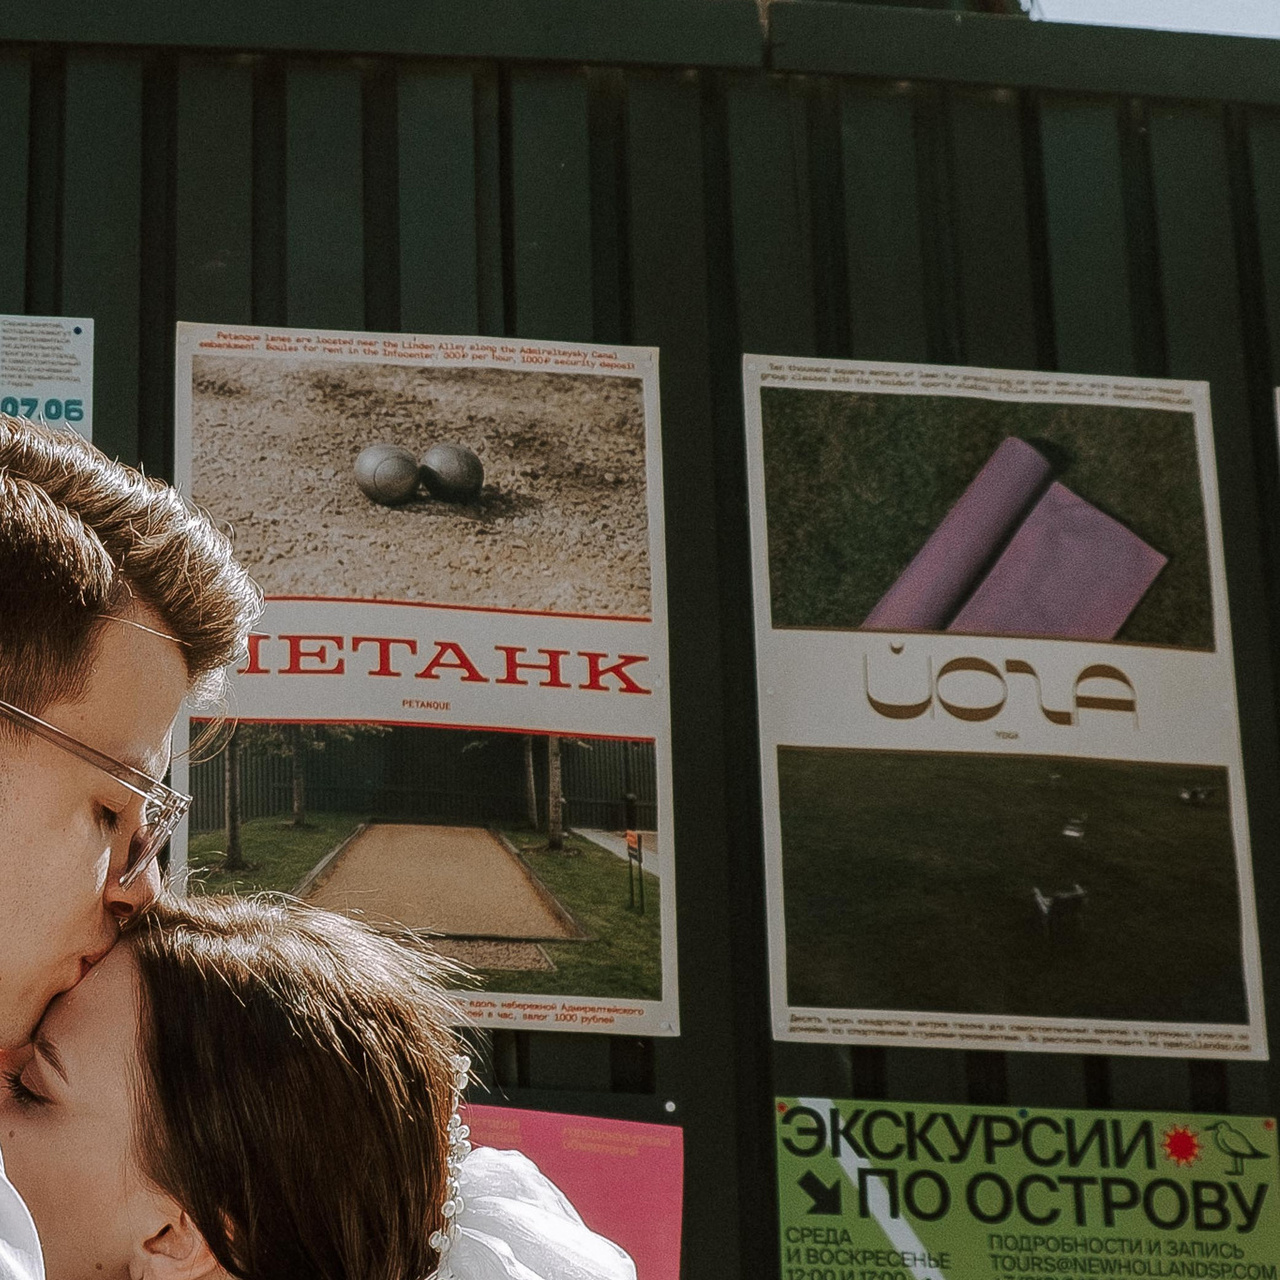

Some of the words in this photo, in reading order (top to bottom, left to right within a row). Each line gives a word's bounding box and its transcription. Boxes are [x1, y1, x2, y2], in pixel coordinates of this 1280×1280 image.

[217, 331, 261, 343] Petanque
[296, 336, 313, 344] are
[316, 336, 354, 346] located
[357, 339, 379, 347] near
[383, 339, 399, 349] the
[402, 341, 435, 351] Linden
[438, 342, 466, 353] Alley
[470, 343, 497, 354] along
[500, 344, 517, 354] the
[591, 351, 618, 360] Canal
[265, 342, 299, 352] Boules
[303, 344, 319, 352] for
[322, 345, 344, 354] rent
[348, 346, 359, 355] in
[363, 347, 379, 356] the
[471, 353, 487, 362] per
[492, 353, 517, 365] hour,
[554, 357, 596, 369] security
[599, 361, 635, 371] deposit
[1, 397, 84, 421] 07.06
[401, 698, 451, 711] PETANQUE
[469, 1000, 497, 1009] вдоль
[554, 1013, 578, 1022] 1000
[581, 1013, 615, 1025] рублей
[780, 1105, 1157, 1170] ЭКСКУРСИИ
[857, 1167, 952, 1221] ПО
[965, 1170, 1269, 1234] ОСТРОВУ
[786, 1226, 853, 1246] СРЕДА
[988, 1233, 1143, 1256] ПОДРОБНОСТИ
[1148, 1239, 1163, 1256] И
[1167, 1240, 1245, 1260] ЗАПИСЬ
[787, 1247, 801, 1264] И
[805, 1248, 952, 1270] ВОСКРЕСЕНЬЕ
[990, 1253, 1278, 1280] TOURS@NEWHOLLANDSP.COM
